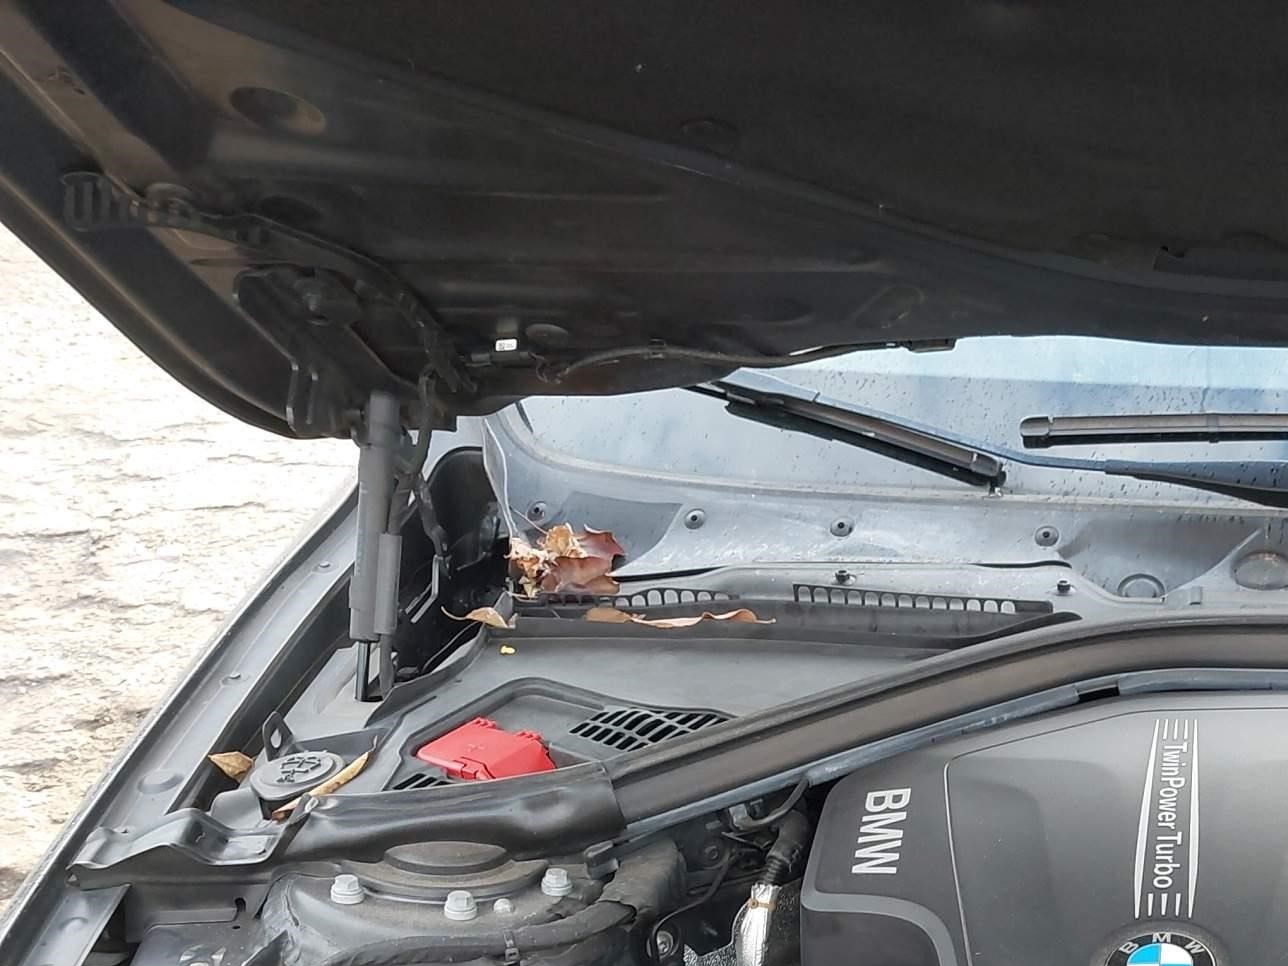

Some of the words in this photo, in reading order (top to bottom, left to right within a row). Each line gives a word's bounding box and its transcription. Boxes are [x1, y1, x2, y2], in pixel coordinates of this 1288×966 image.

[1157, 741, 1188, 830] TwinPower
[852, 787, 911, 873] BMW
[1152, 831, 1183, 889] Turbo
[1119, 932, 1204, 954] BMW
